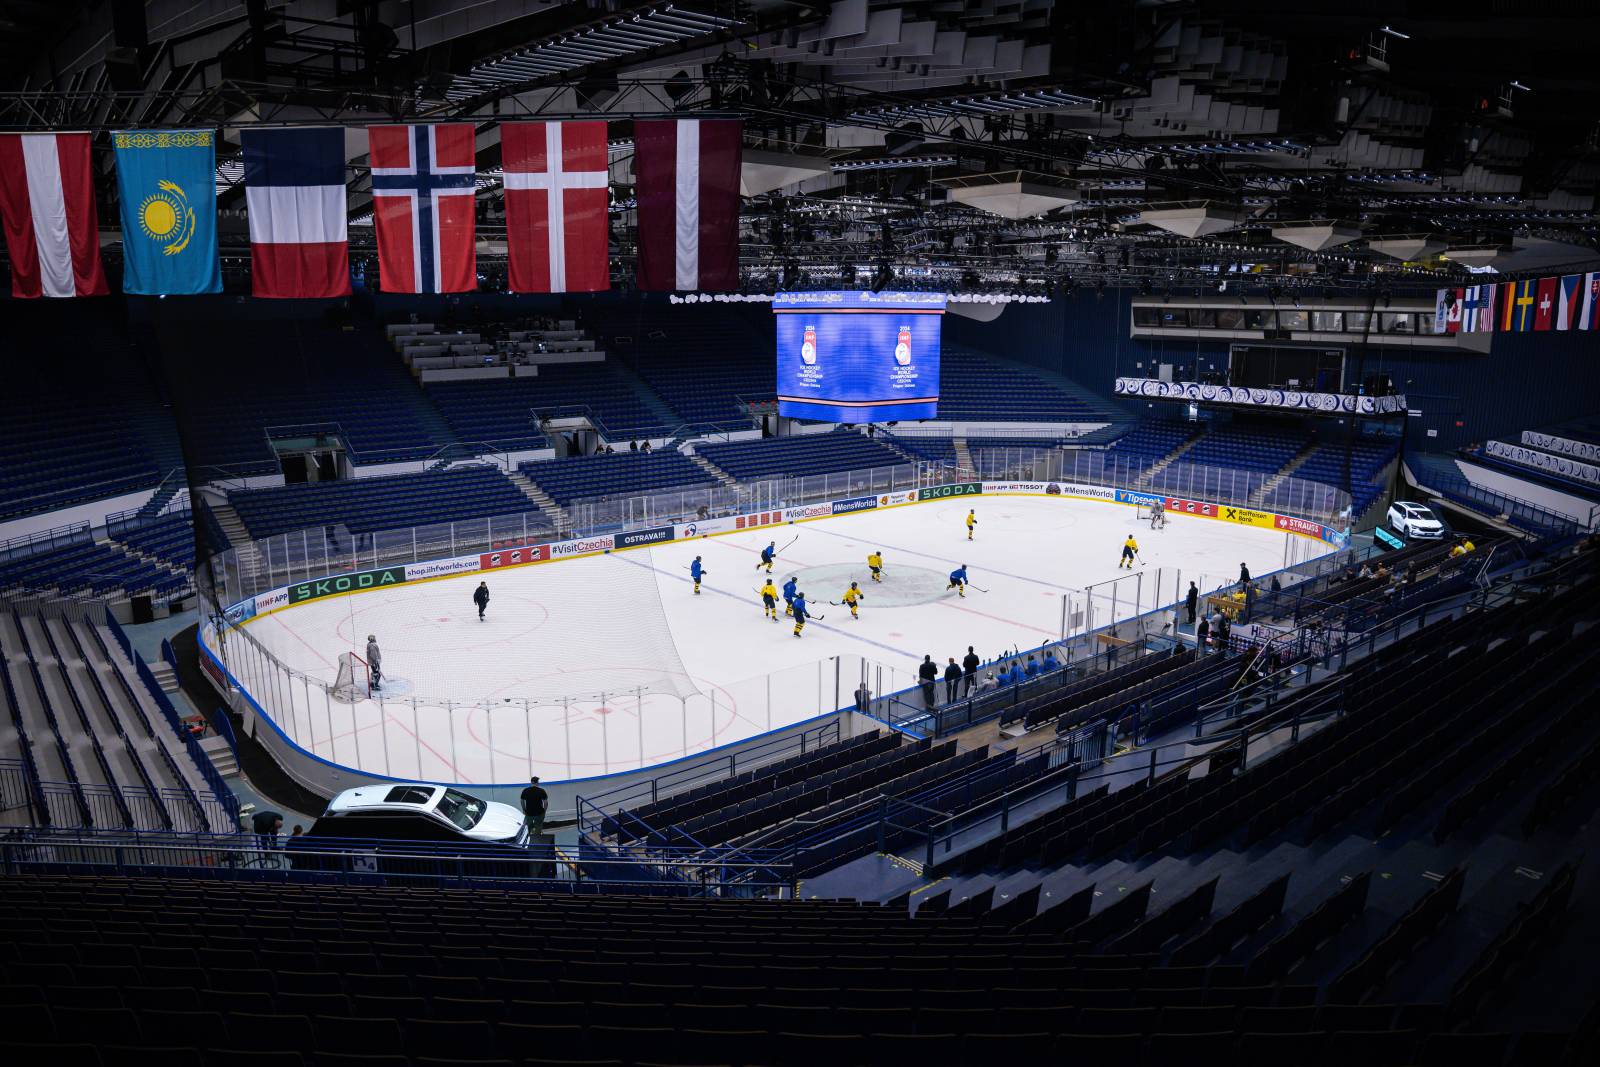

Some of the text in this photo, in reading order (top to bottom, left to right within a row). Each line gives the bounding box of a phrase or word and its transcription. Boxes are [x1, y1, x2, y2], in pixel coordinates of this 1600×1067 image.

[1064, 487, 1114, 499] #MensWorlds
[785, 504, 832, 519] #VisitCzechia
[833, 499, 877, 513] #MensWorlds
[1289, 519, 1319, 533] STRAUSS
[624, 531, 666, 544] OSTRAVA!!!
[552, 538, 613, 555] #VisitCzechia
[407, 559, 480, 577] shop.iihfworlds.com
[274, 593, 288, 603] APP
